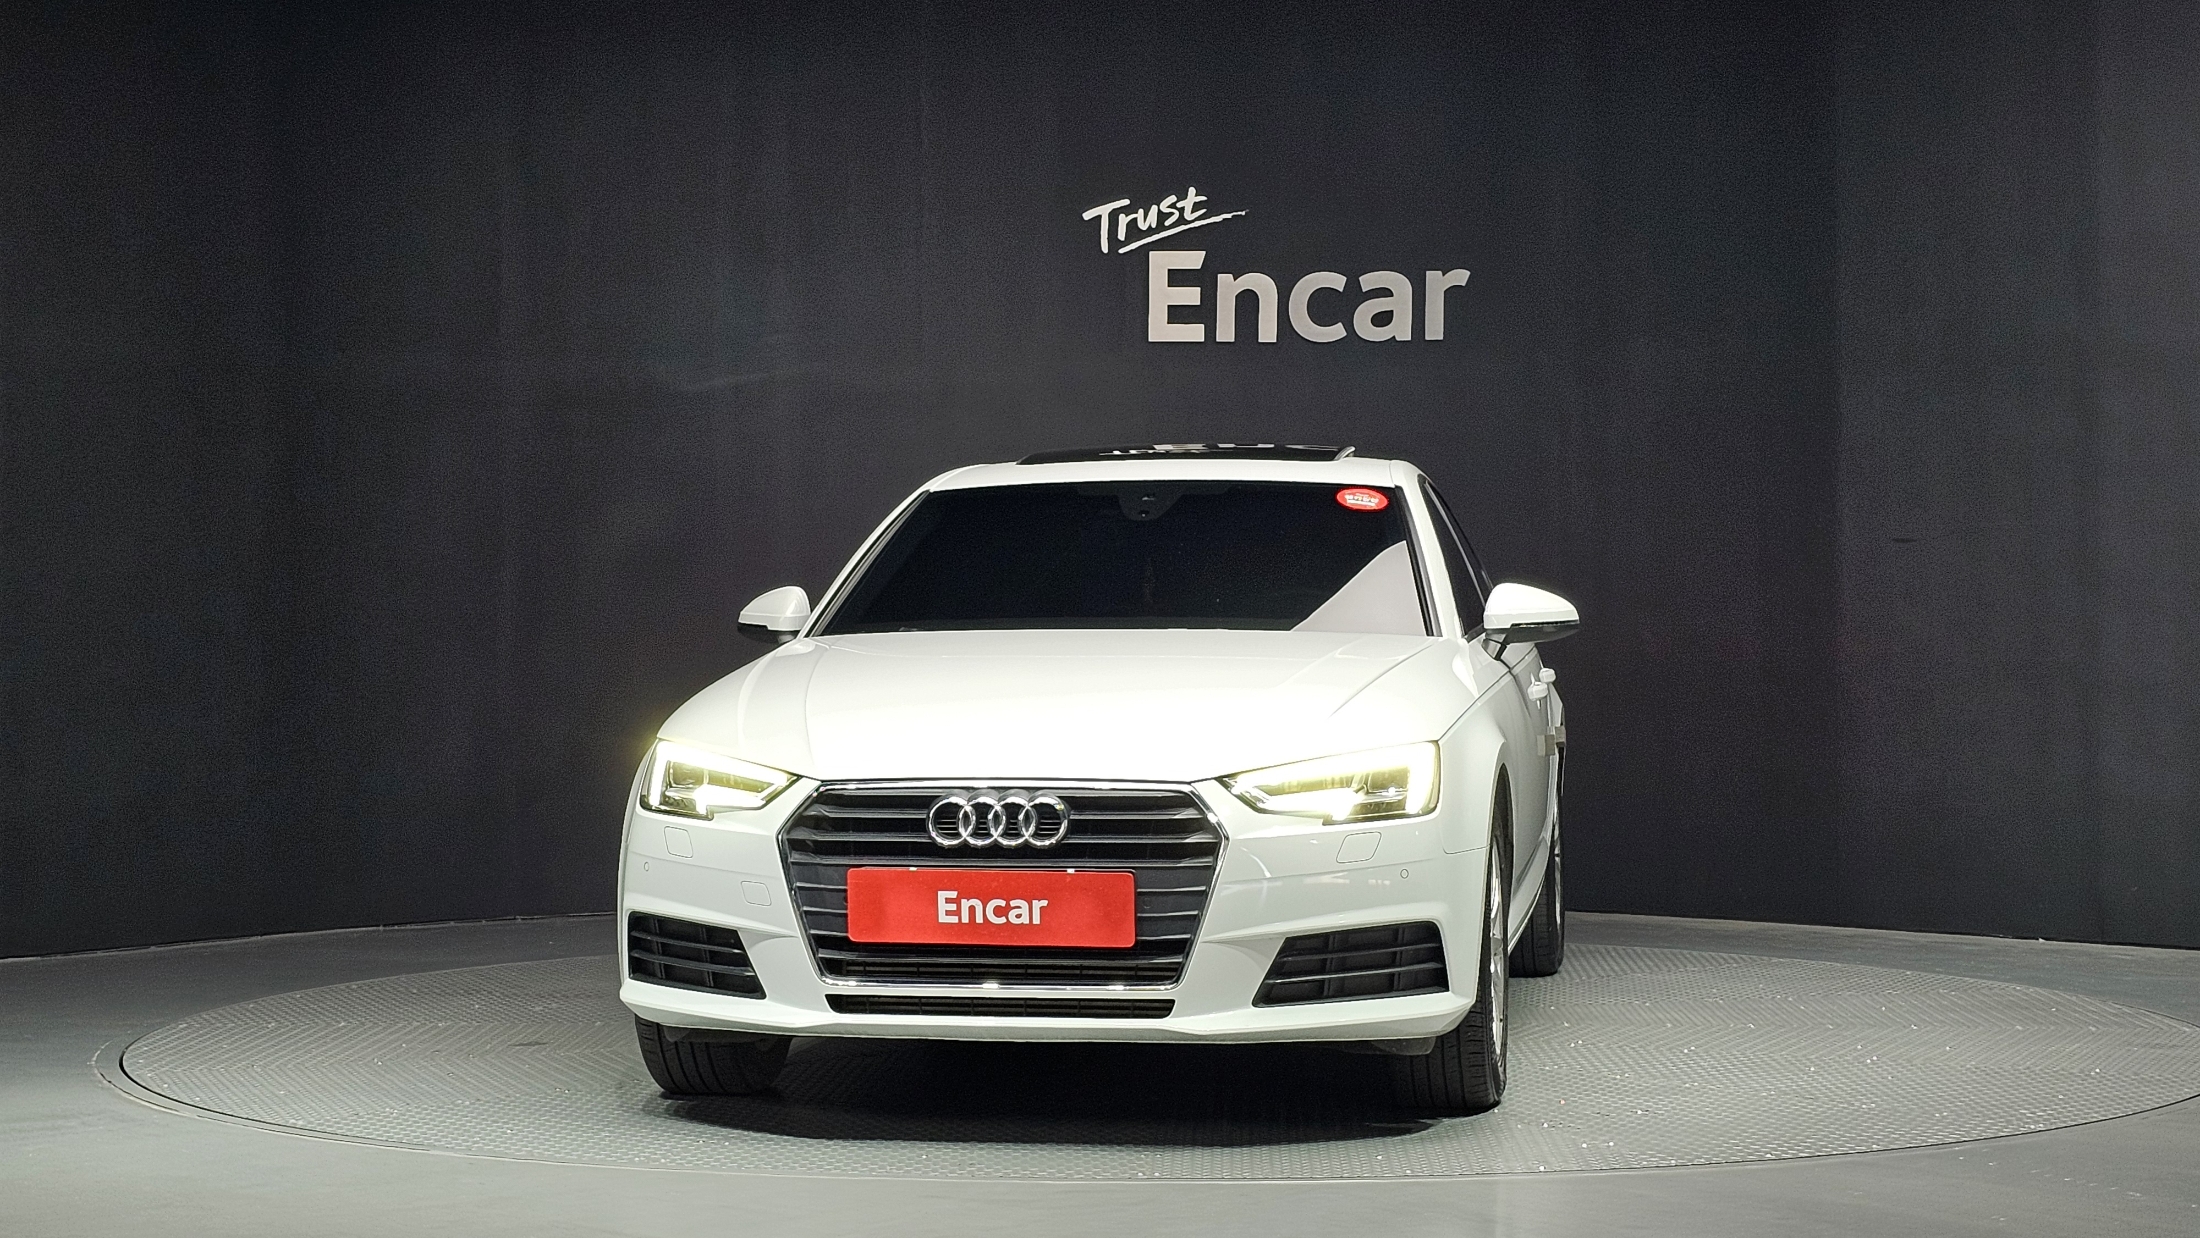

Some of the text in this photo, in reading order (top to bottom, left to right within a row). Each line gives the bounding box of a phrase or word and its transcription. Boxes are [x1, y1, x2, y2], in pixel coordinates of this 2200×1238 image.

[1082, 187, 1208, 253] Trust
[1148, 251, 1471, 342] Encar
[937, 890, 1048, 925] Encar
